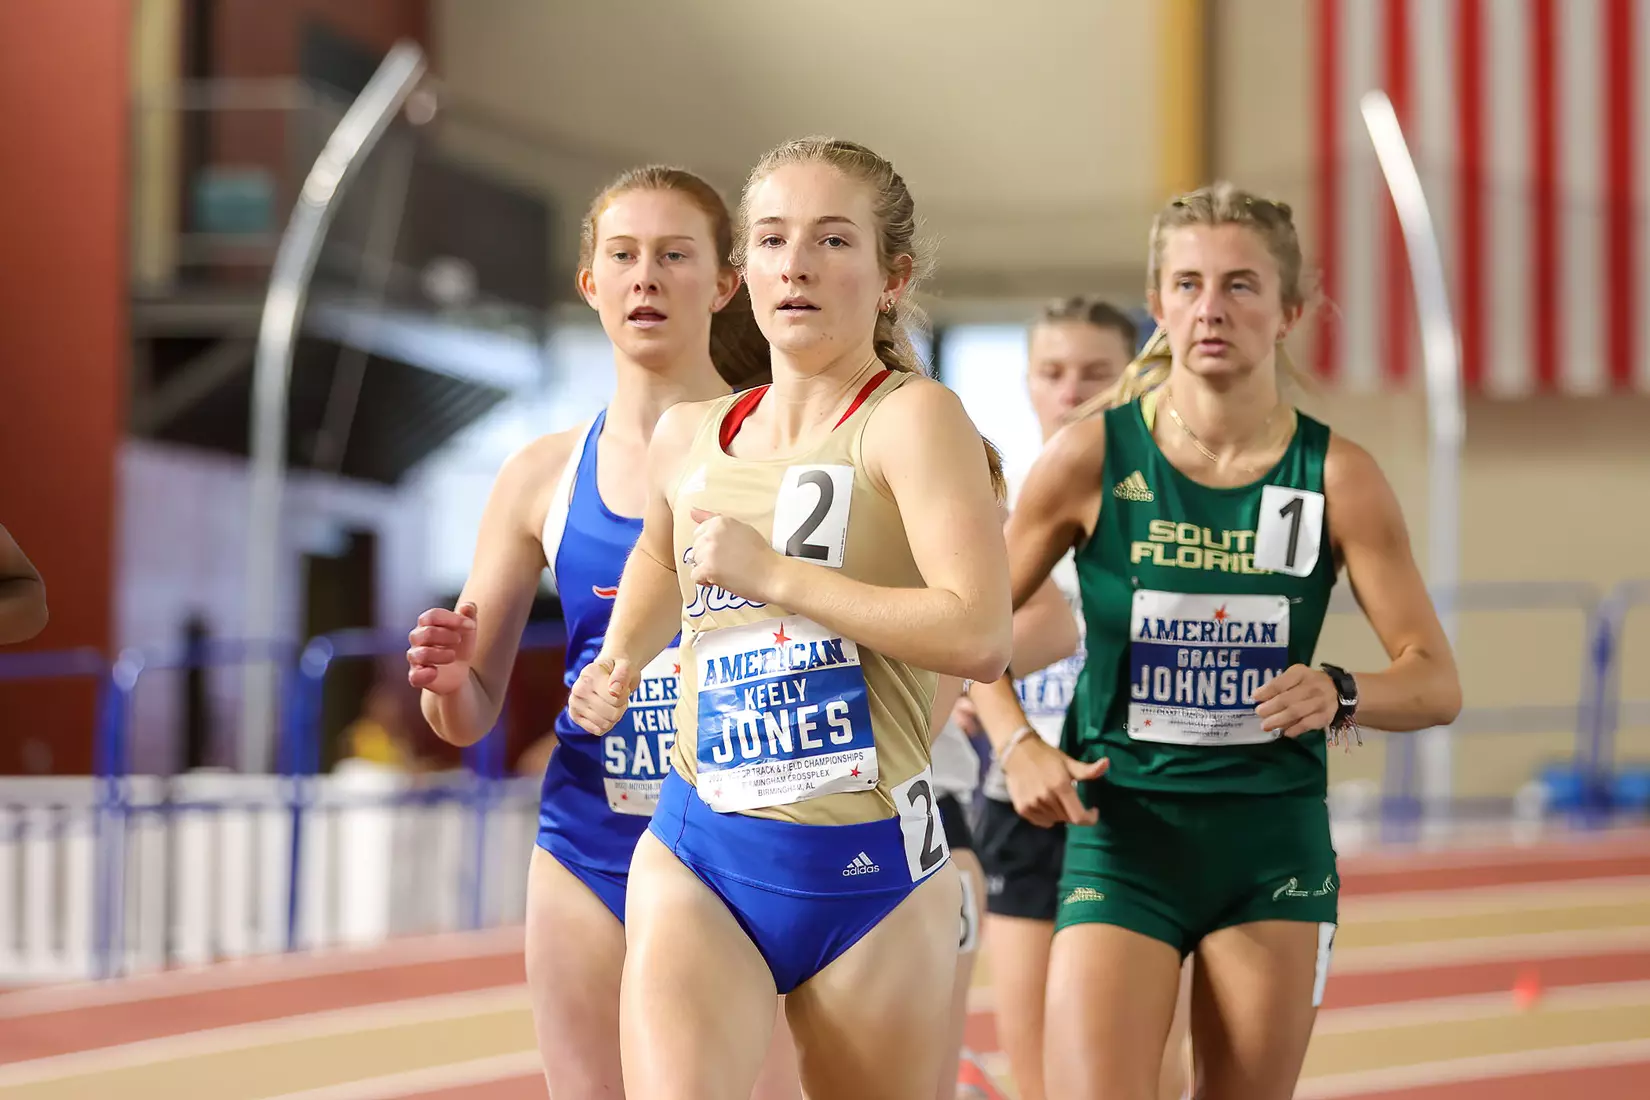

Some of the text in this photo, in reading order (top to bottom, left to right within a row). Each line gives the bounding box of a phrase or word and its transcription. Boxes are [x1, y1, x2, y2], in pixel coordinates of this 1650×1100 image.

[784, 468, 835, 561] 2
[1148, 519, 1256, 553] SOUT
[1278, 496, 1304, 568] 1
[1130, 541, 1274, 575] FLORID
[1139, 617, 1278, 644] AMERICAN
[703, 638, 848, 687] AMERICAN
[1177, 648, 1242, 669] GRACE
[743, 678, 807, 712] KEELY
[711, 700, 853, 764] JONES
[752, 765, 775, 776] TRACK
[776, 765, 782, 773] &
[782, 761, 802, 772] FIELD
[804, 751, 864, 769] CHAMPIONSHIPS
[787, 768, 830, 782] CROSSPLEX
[805, 781, 816, 789] AL
[906, 779, 944, 872] 2
[842, 863, 880, 877] adidas
